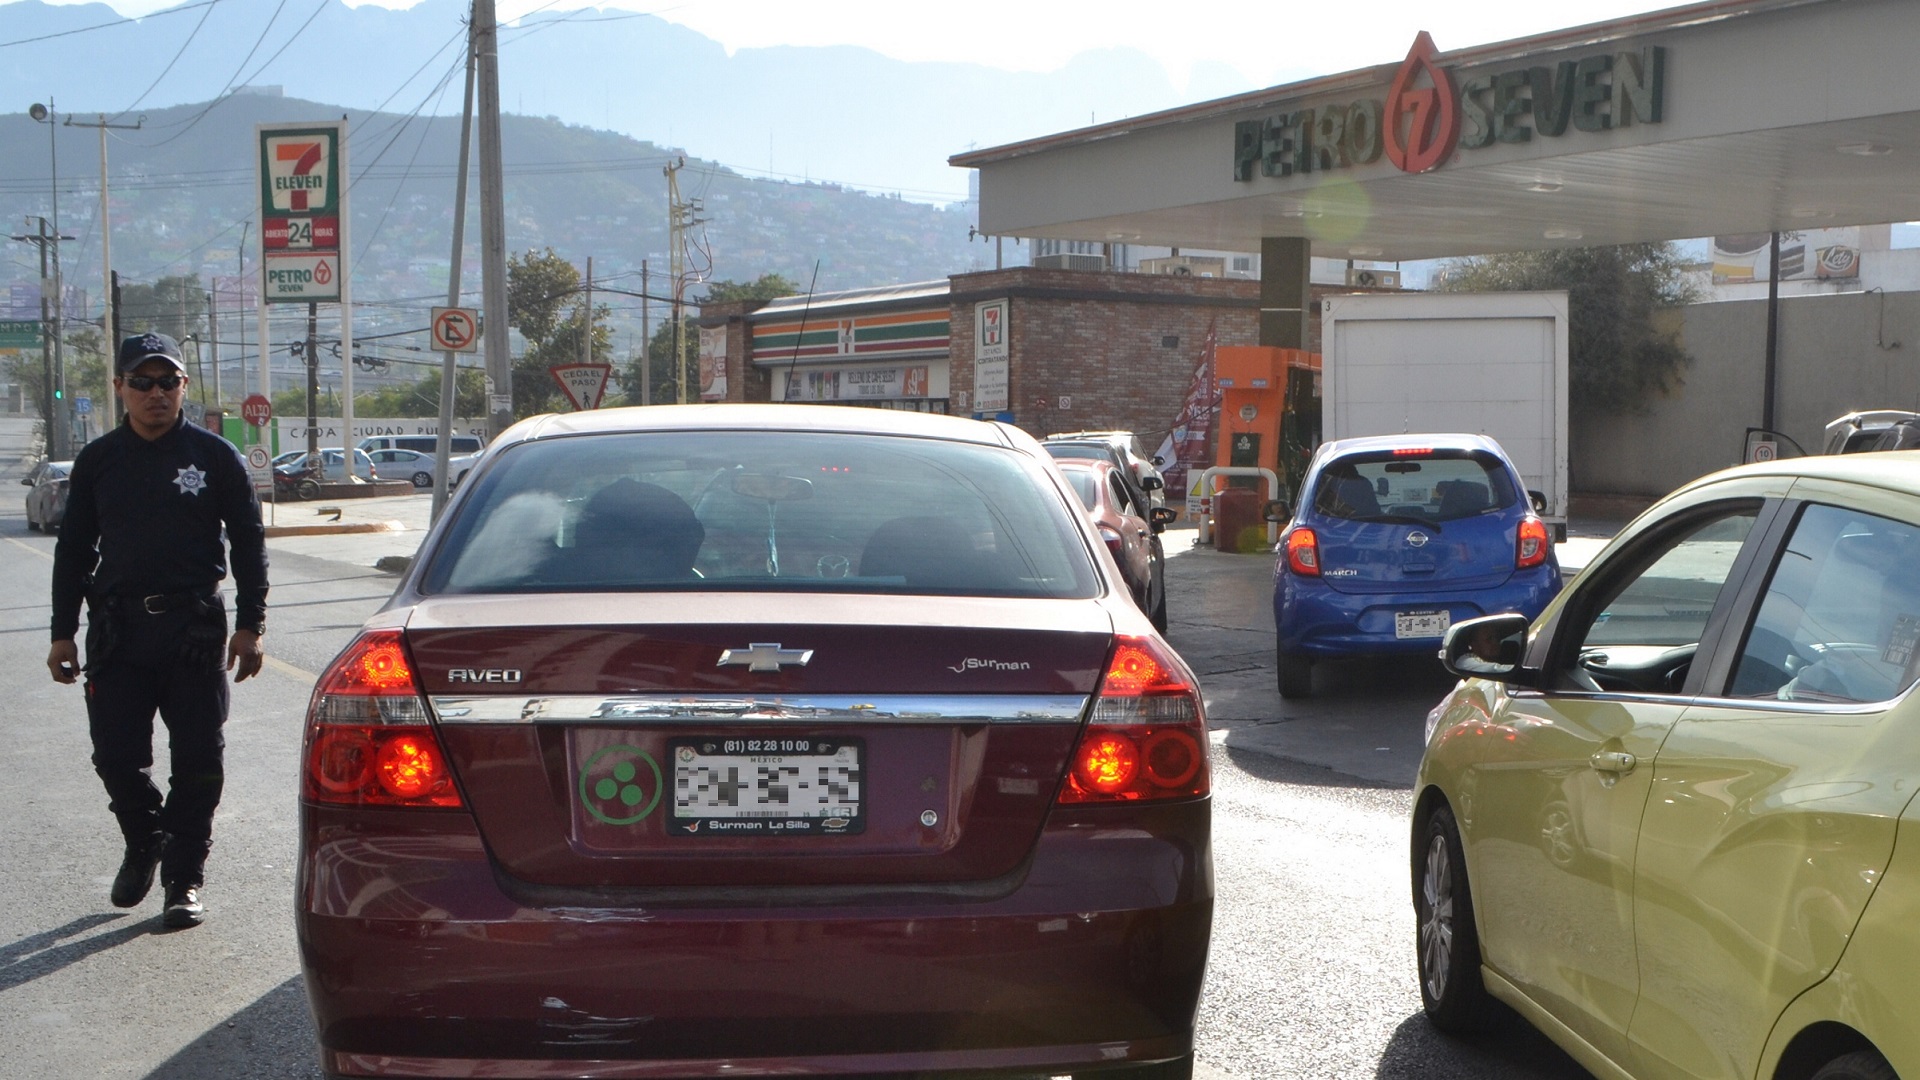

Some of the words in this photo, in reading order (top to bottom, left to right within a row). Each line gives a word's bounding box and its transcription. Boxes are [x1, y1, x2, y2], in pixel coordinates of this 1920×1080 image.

[1234, 101, 1384, 182] PETRO
[1401, 88, 1439, 171] 7
[1459, 46, 1665, 150] SEVEN
[277, 143, 321, 210] 7
[265, 229, 288, 238] ABIERTO
[289, 222, 312, 243] 24
[314, 228, 333, 237] HORAS
[269, 269, 312, 283] PETRO
[278, 284, 303, 293] SEVEN
[1326, 301, 1331, 311] 3
[563, 371, 589, 379] CEDA
[77, 402, 89, 411] 15
[245, 405, 269, 417] ALTO
[254, 453, 262, 461] 10
[1760, 450, 1769, 458] 10
[967, 658, 1030, 670] Surman
[448, 669, 521, 682] AVEO
[724, 741, 745, 753] (81)
[748, 741, 760, 751] 82
[764, 741, 777, 751] 28
[780, 741, 793, 751] 10
[796, 741, 809, 751] 00
[709, 821, 762, 829] Surman
[769, 821, 784, 829] La
[786, 821, 810, 829] Silla
